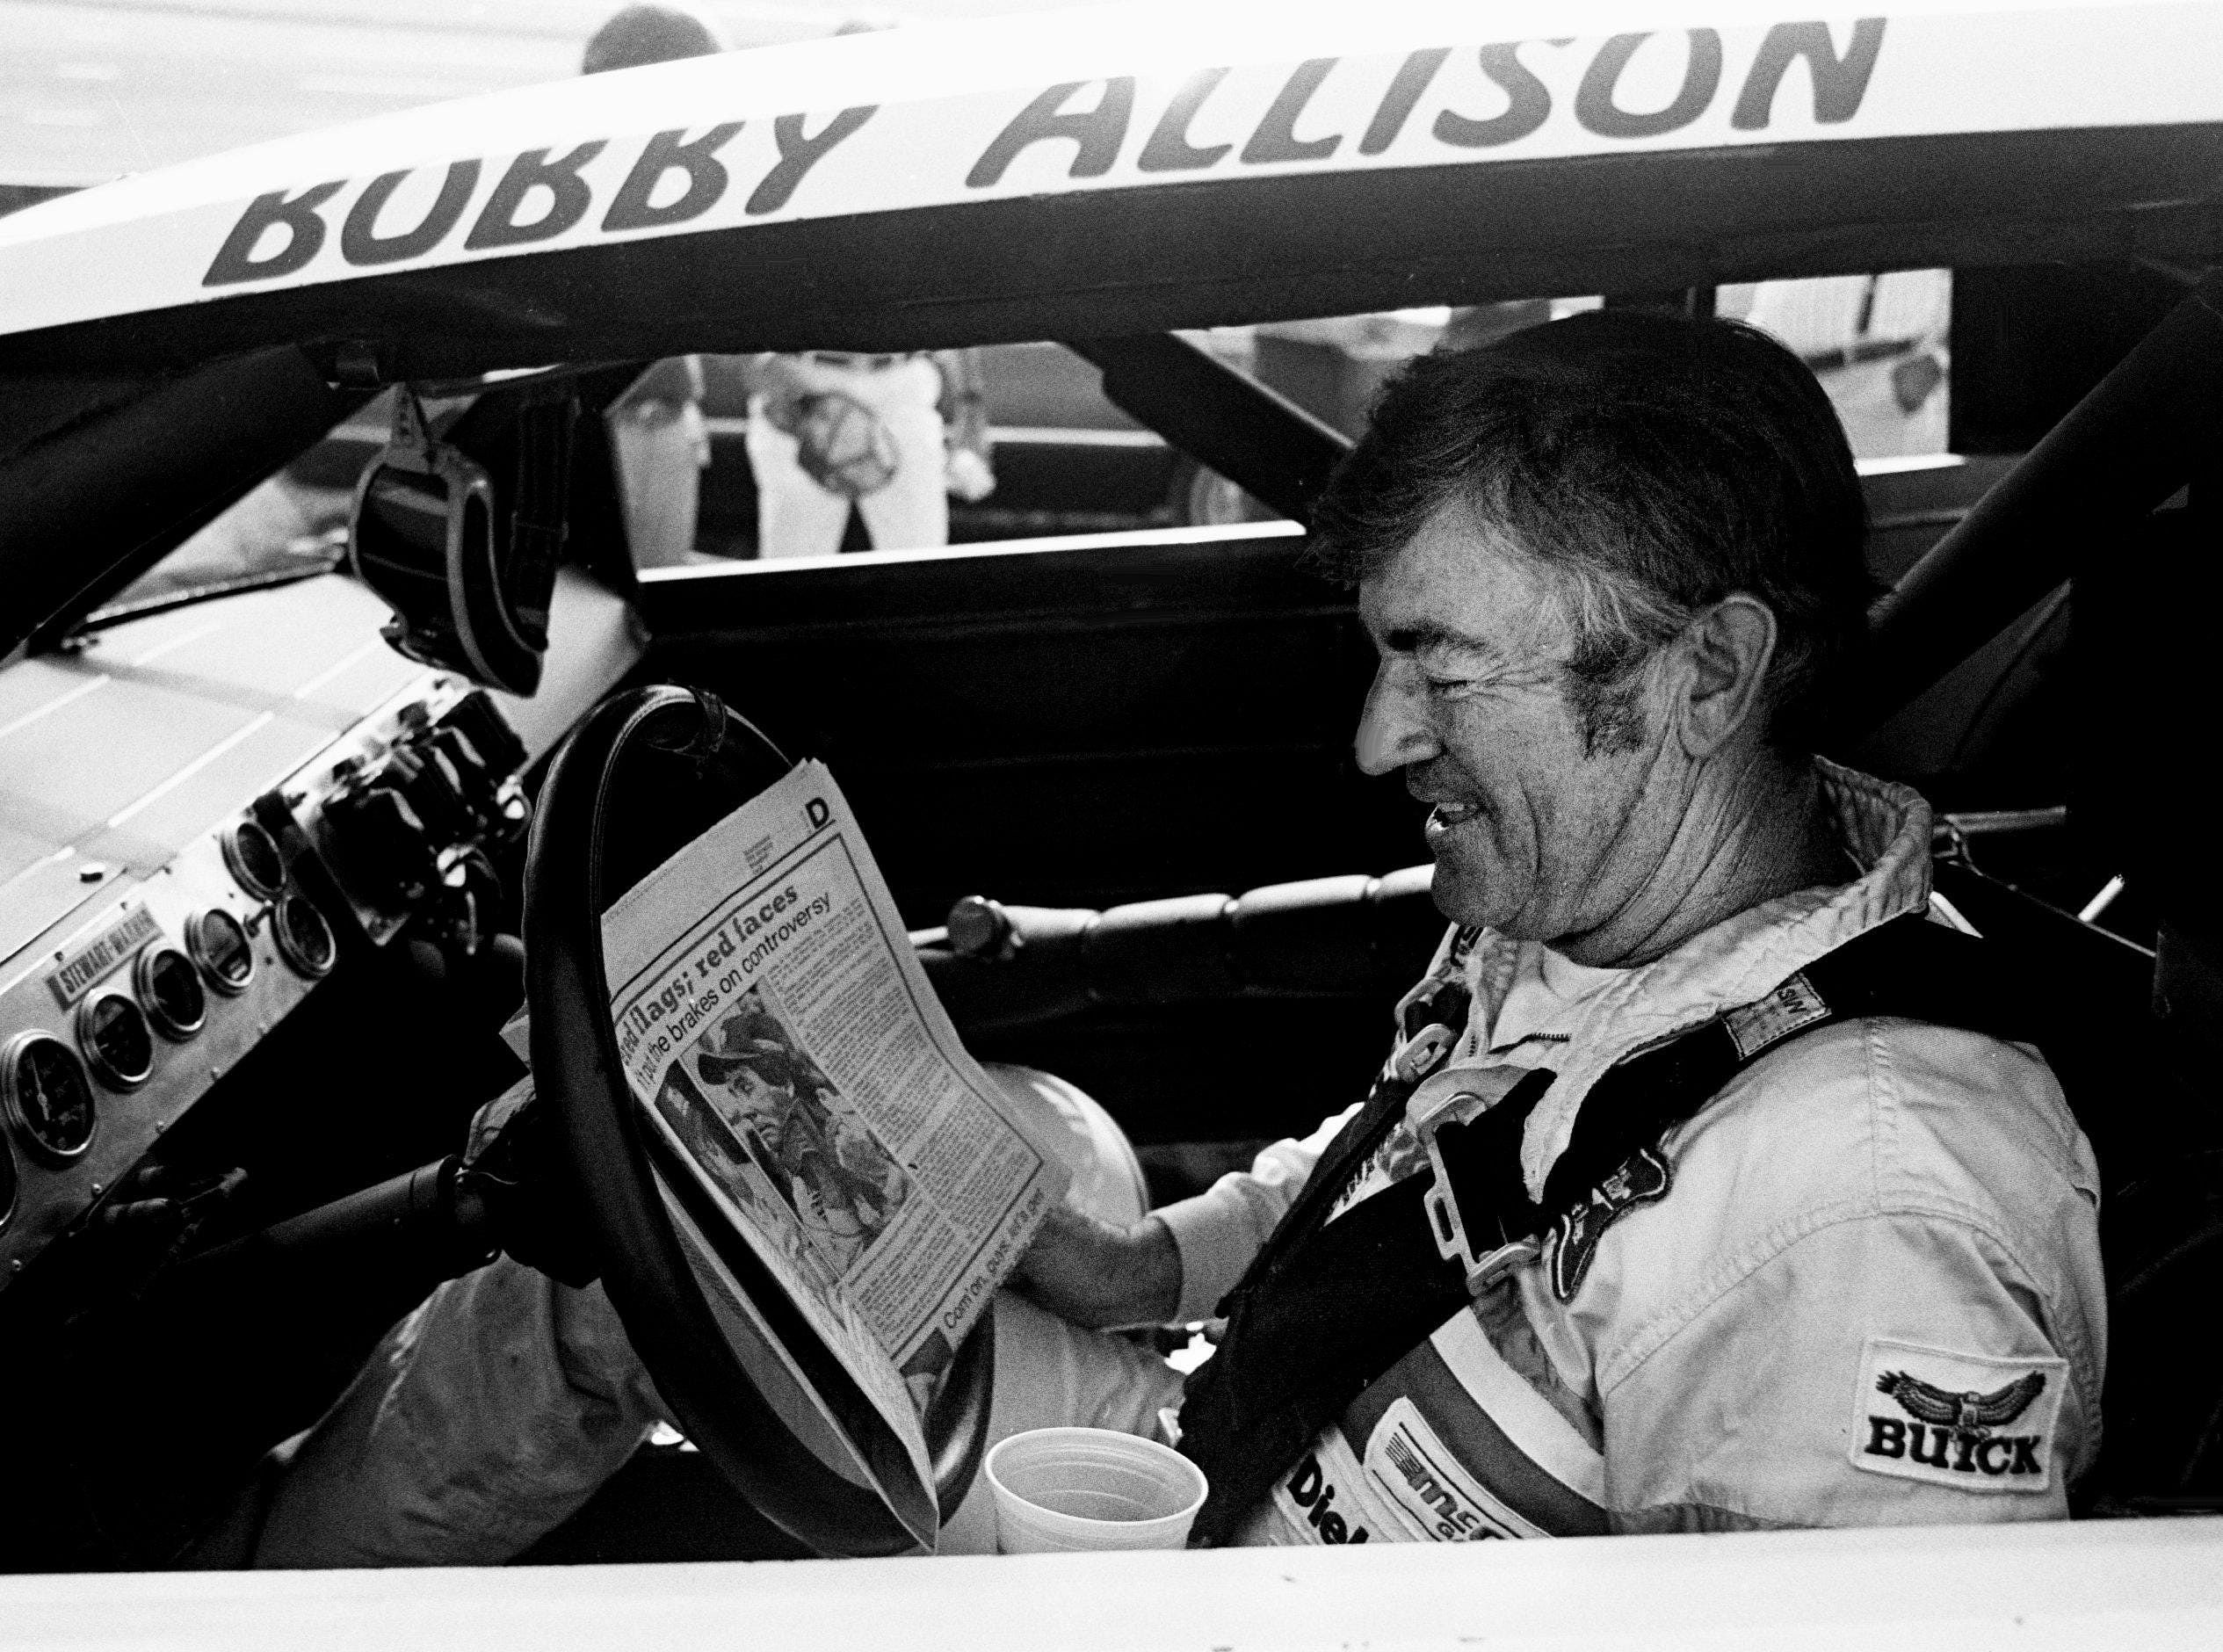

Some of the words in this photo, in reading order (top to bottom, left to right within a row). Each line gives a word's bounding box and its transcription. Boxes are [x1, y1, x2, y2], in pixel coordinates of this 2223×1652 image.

[964, 17, 1887, 188] ALLISON
[805, 796, 829, 829] D
[629, 971, 694, 1035] flags;
[695, 930, 736, 978] red
[733, 886, 798, 943] faces
[647, 1035, 670, 1061] the
[666, 989, 719, 1042] brakes
[720, 968, 742, 994] on
[742, 892, 830, 974] controversy
[1864, 1415, 2043, 1475] BUICK
